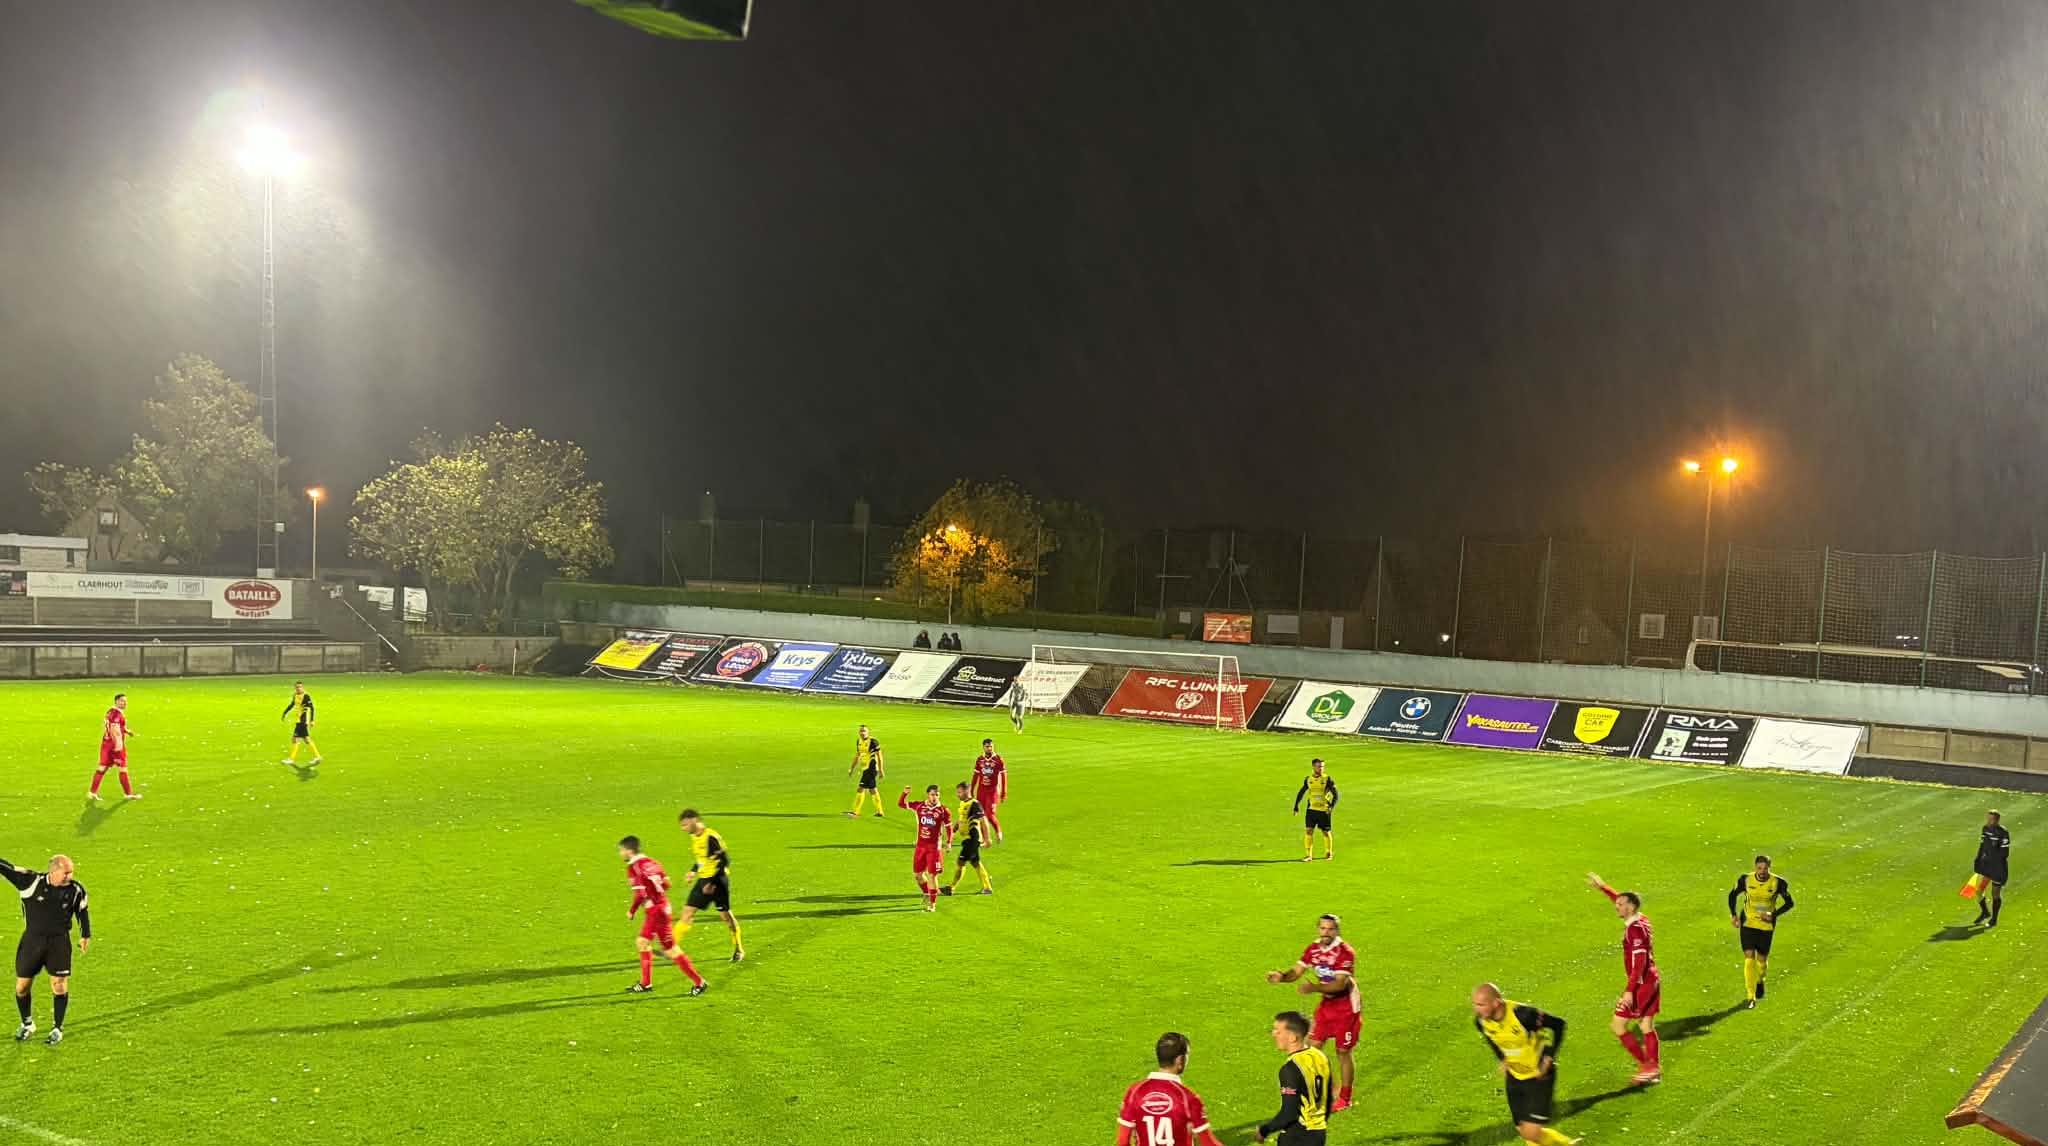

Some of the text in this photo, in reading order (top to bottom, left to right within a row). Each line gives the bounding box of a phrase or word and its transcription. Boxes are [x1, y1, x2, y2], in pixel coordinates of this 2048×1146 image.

[228, 590, 277, 601] BATAILLE
[783, 654, 816, 666] Krys
[1145, 677, 1248, 693] RFC LUINGNE
[1315, 697, 1345, 715] DL
[1667, 714, 1739, 730] RMA
[1345, 1031, 1353, 1042] 6
[1315, 1075, 1323, 1104] 9
[1142, 1115, 1175, 1146] 14
